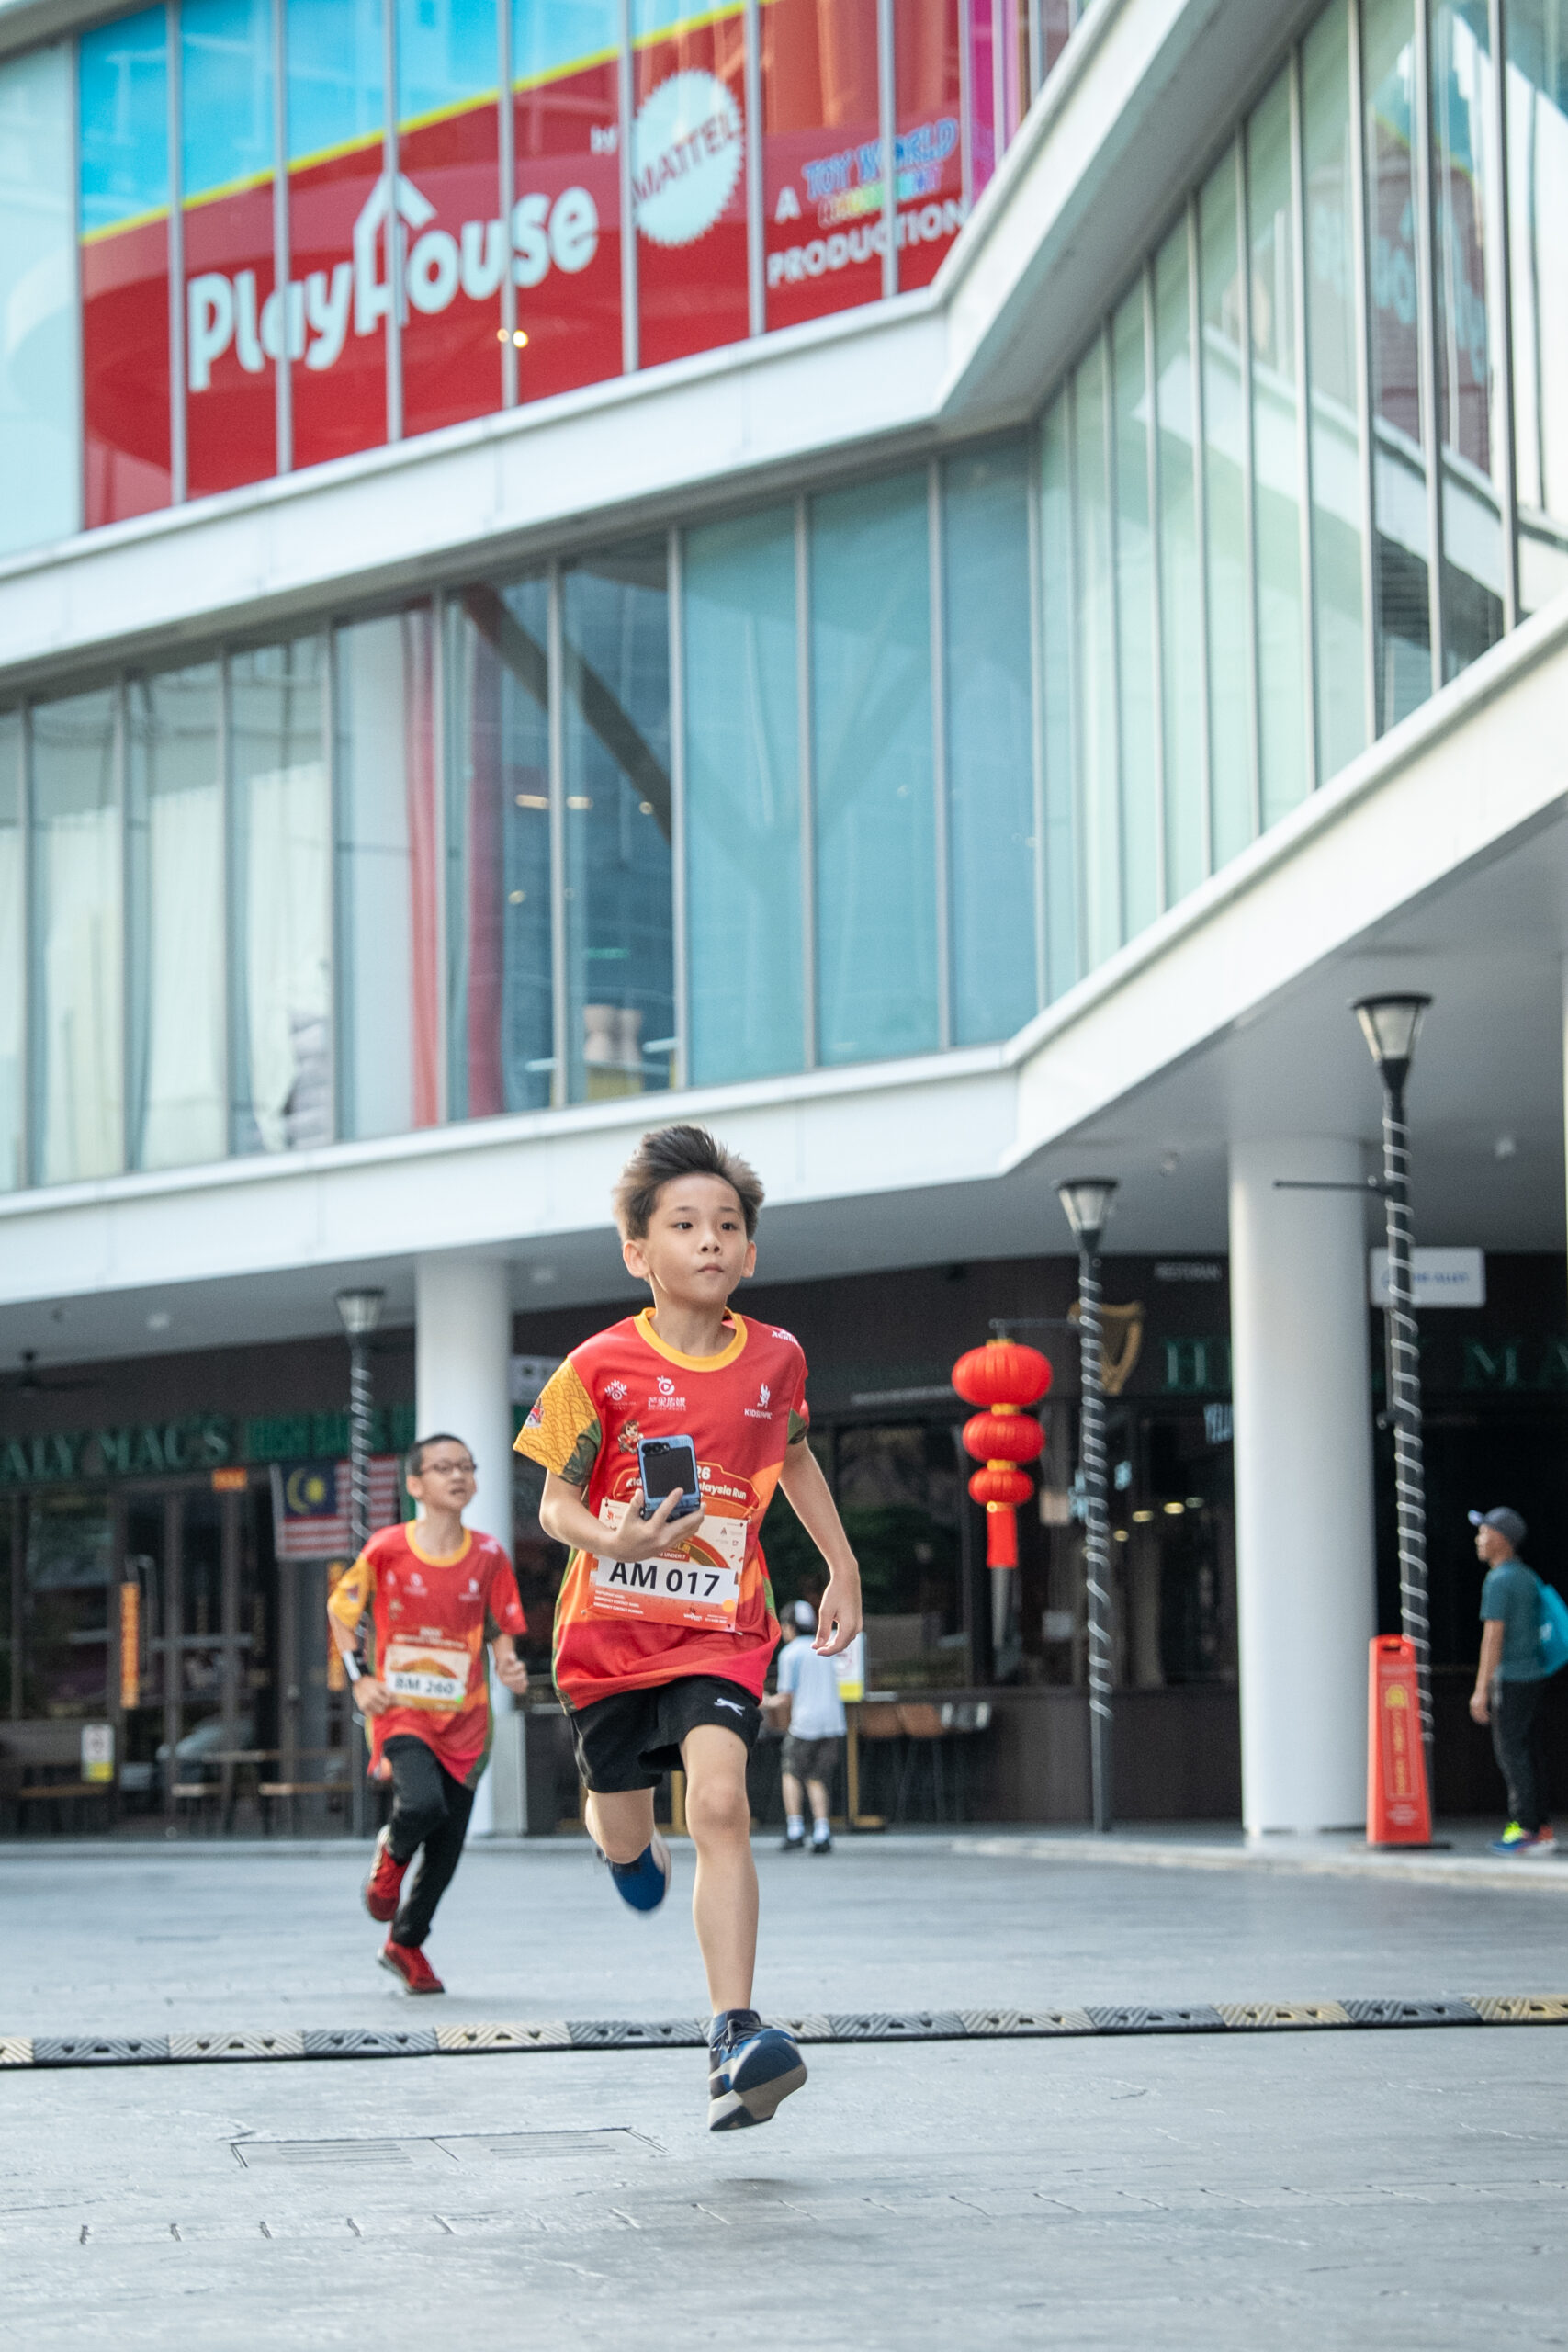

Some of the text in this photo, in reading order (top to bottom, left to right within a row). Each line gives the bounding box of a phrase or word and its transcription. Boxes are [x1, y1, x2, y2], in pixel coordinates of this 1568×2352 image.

[632, 112, 736, 199] MATTEL
[774, 187, 802, 224] A
[767, 197, 971, 288] PRODUCTION
[732, 1487, 747, 1499] Run
[609, 1562, 720, 1597] AM 017
